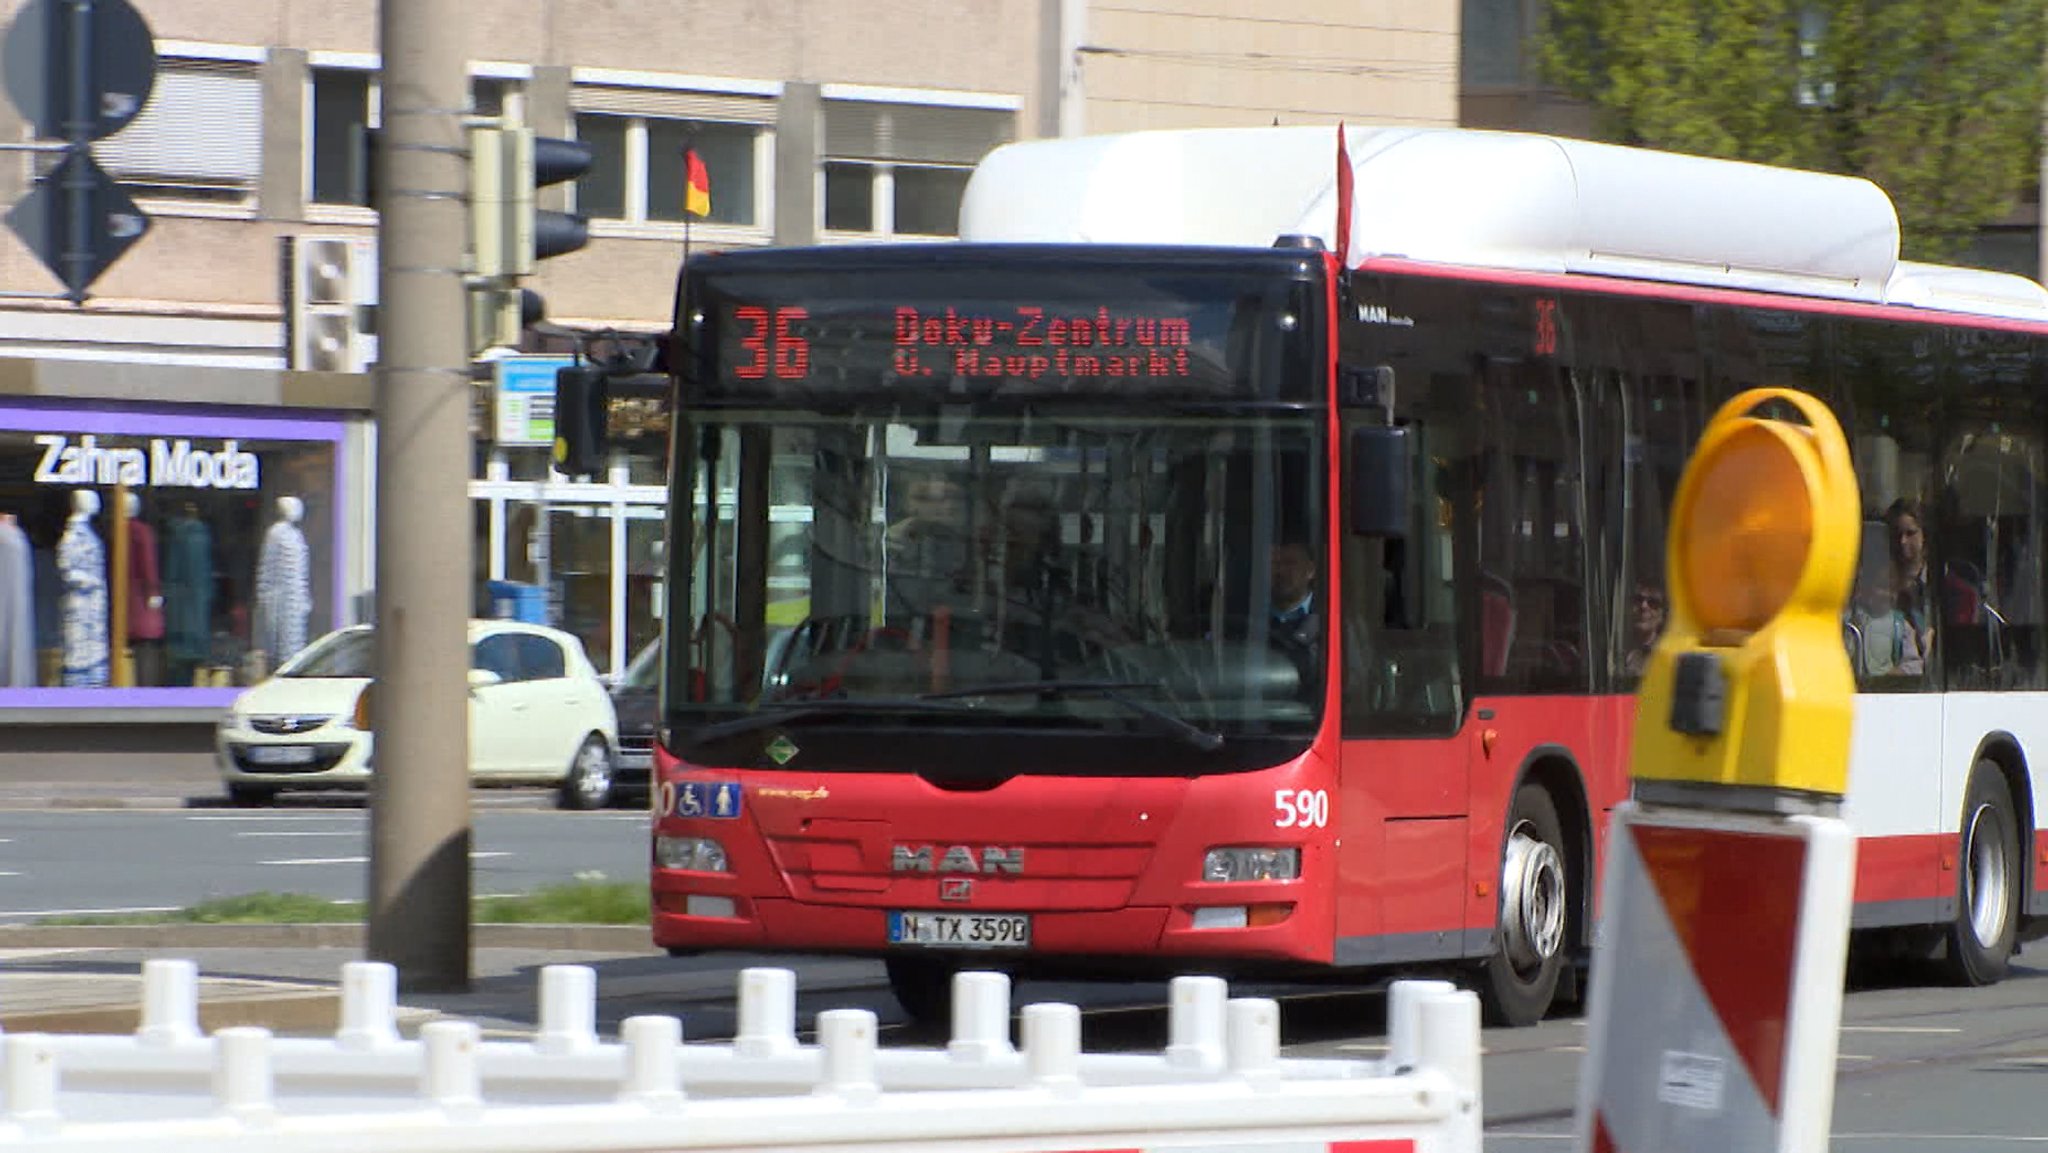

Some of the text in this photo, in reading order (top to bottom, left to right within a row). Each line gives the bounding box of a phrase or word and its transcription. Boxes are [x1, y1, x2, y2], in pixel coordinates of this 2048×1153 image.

[895, 305, 1191, 346] Doku-Zentrum
[1358, 304, 1388, 323] MAN
[735, 305, 809, 379] 36
[956, 348, 1191, 379] Hauptmarkt
[34, 434, 259, 488] Zahra Moda
[1275, 789, 1329, 829] 590
[892, 845, 1025, 873] MAN
[969, 918, 1025, 942] 3590
